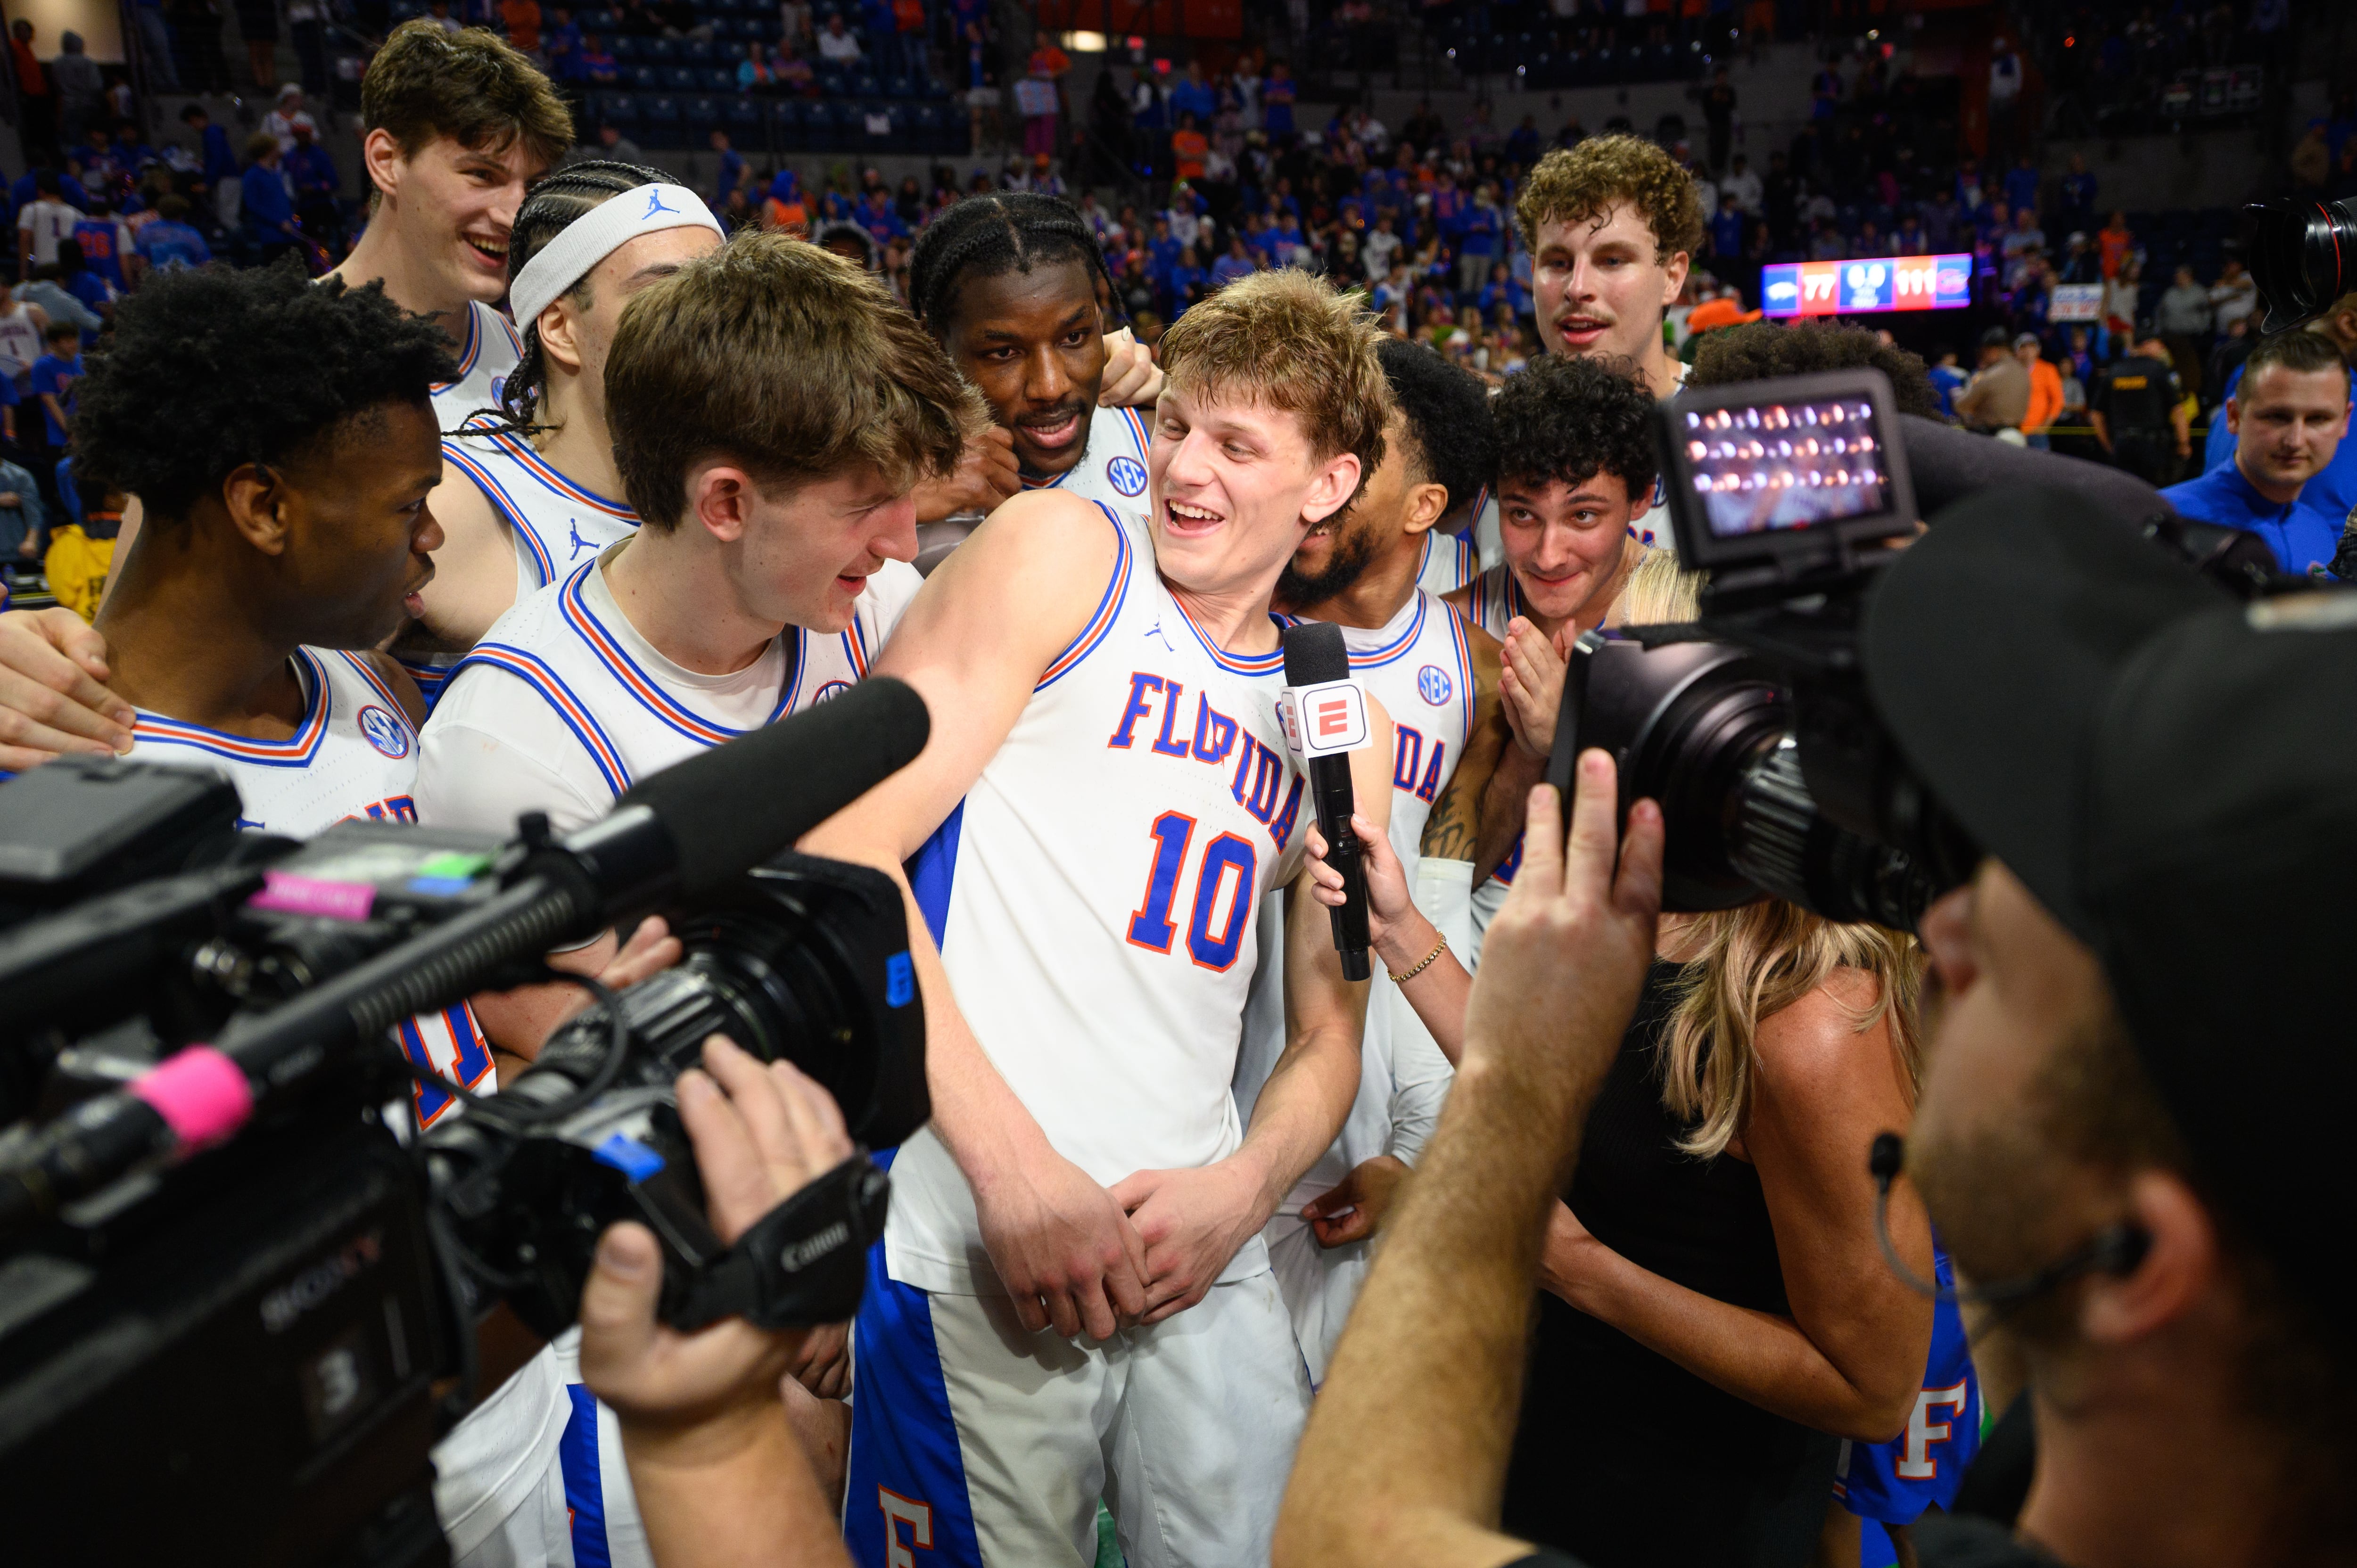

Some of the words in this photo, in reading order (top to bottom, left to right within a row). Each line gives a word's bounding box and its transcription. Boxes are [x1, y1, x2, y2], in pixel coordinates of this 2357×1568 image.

[1804, 273, 1836, 301] 77
[1895, 268, 1937, 296] 111
[1109, 458, 1146, 494] SEC
[1418, 666, 1450, 704] SEC
[361, 707, 406, 755] SEC
[1391, 720, 1445, 806] DA
[1126, 809, 1258, 973] 10
[780, 1222, 849, 1272] Canon
[1895, 1376, 1968, 1480] F
